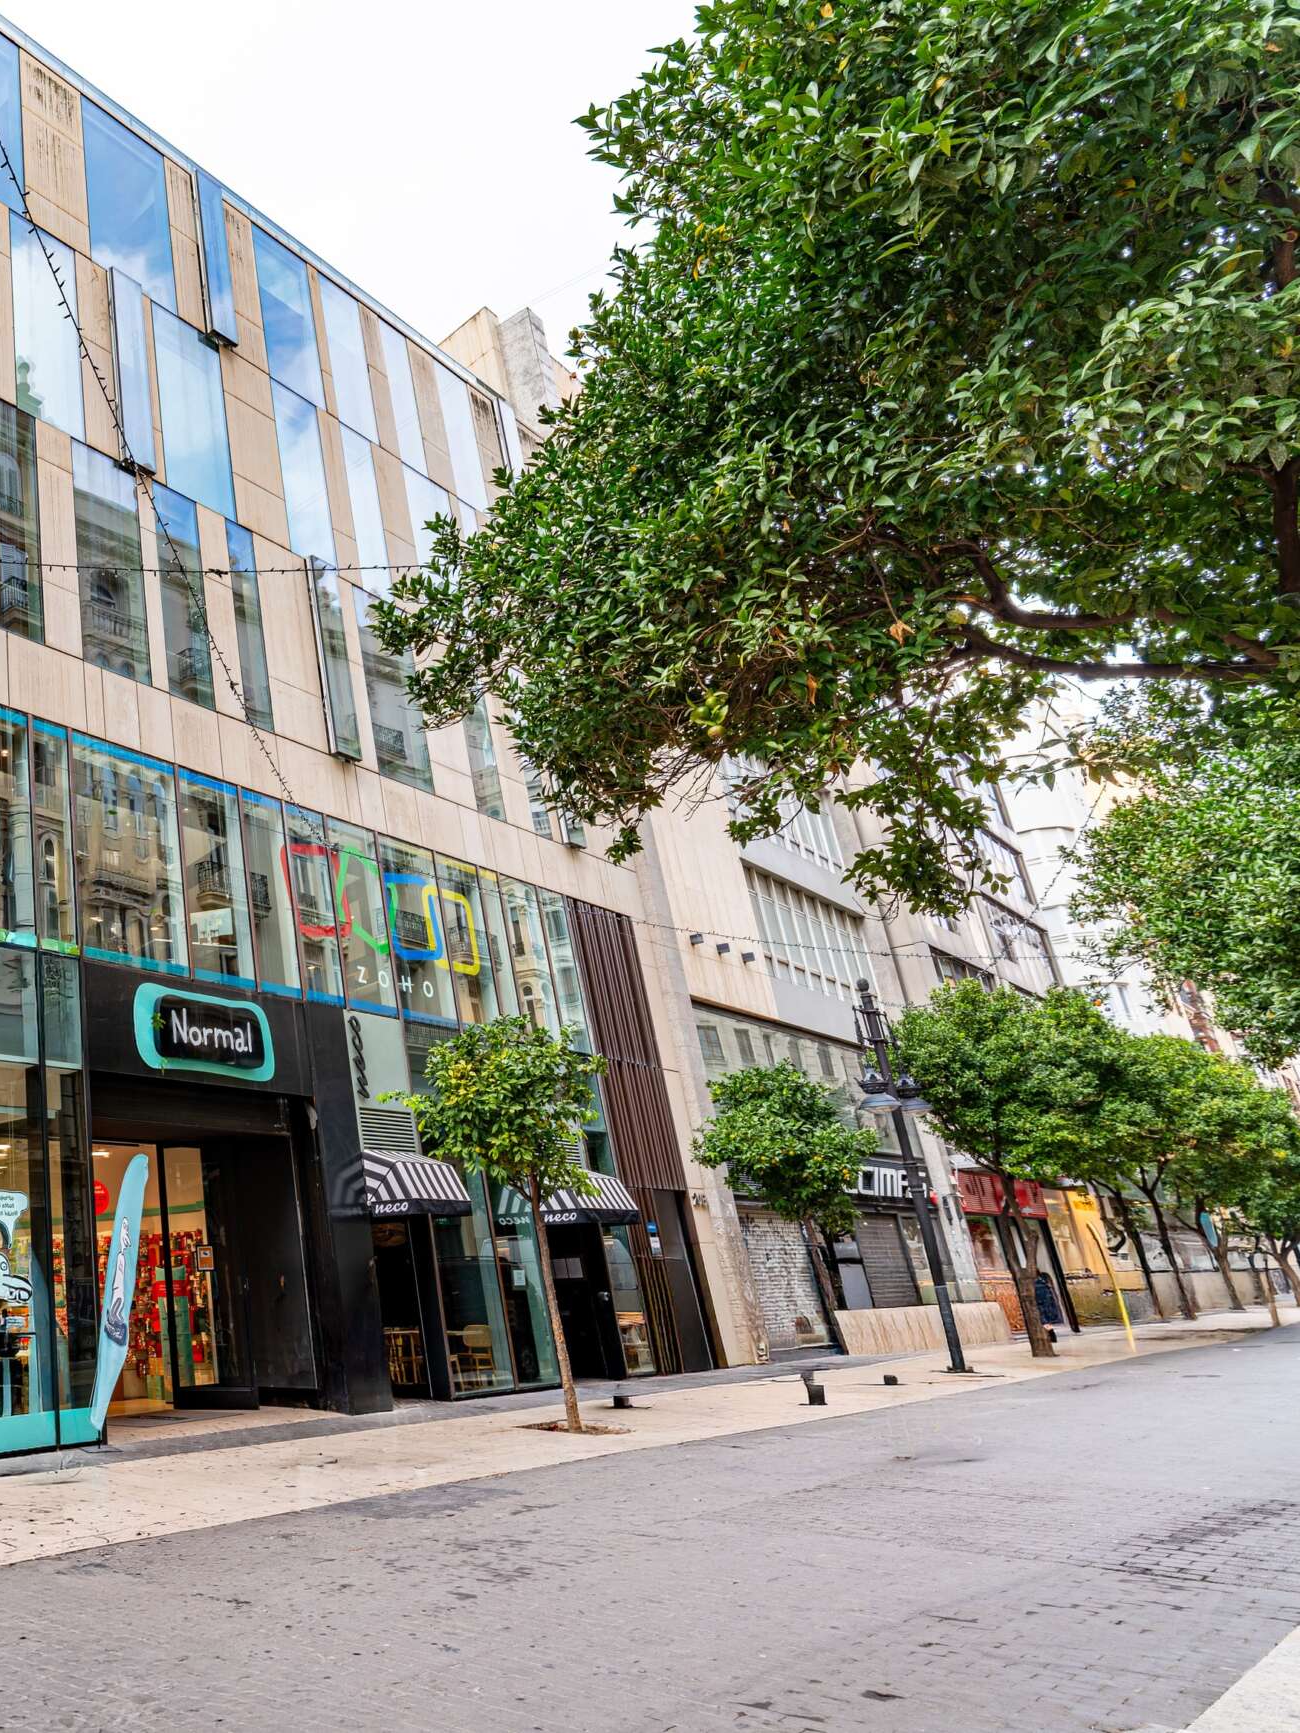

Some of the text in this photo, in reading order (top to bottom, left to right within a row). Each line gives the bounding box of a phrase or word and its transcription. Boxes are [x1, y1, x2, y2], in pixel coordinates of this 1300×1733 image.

[356, 965, 434, 998] ZOHO
[171, 1008, 252, 1053] Normal
[375, 1201, 409, 1215] neco
[544, 1212, 577, 1223] neco
